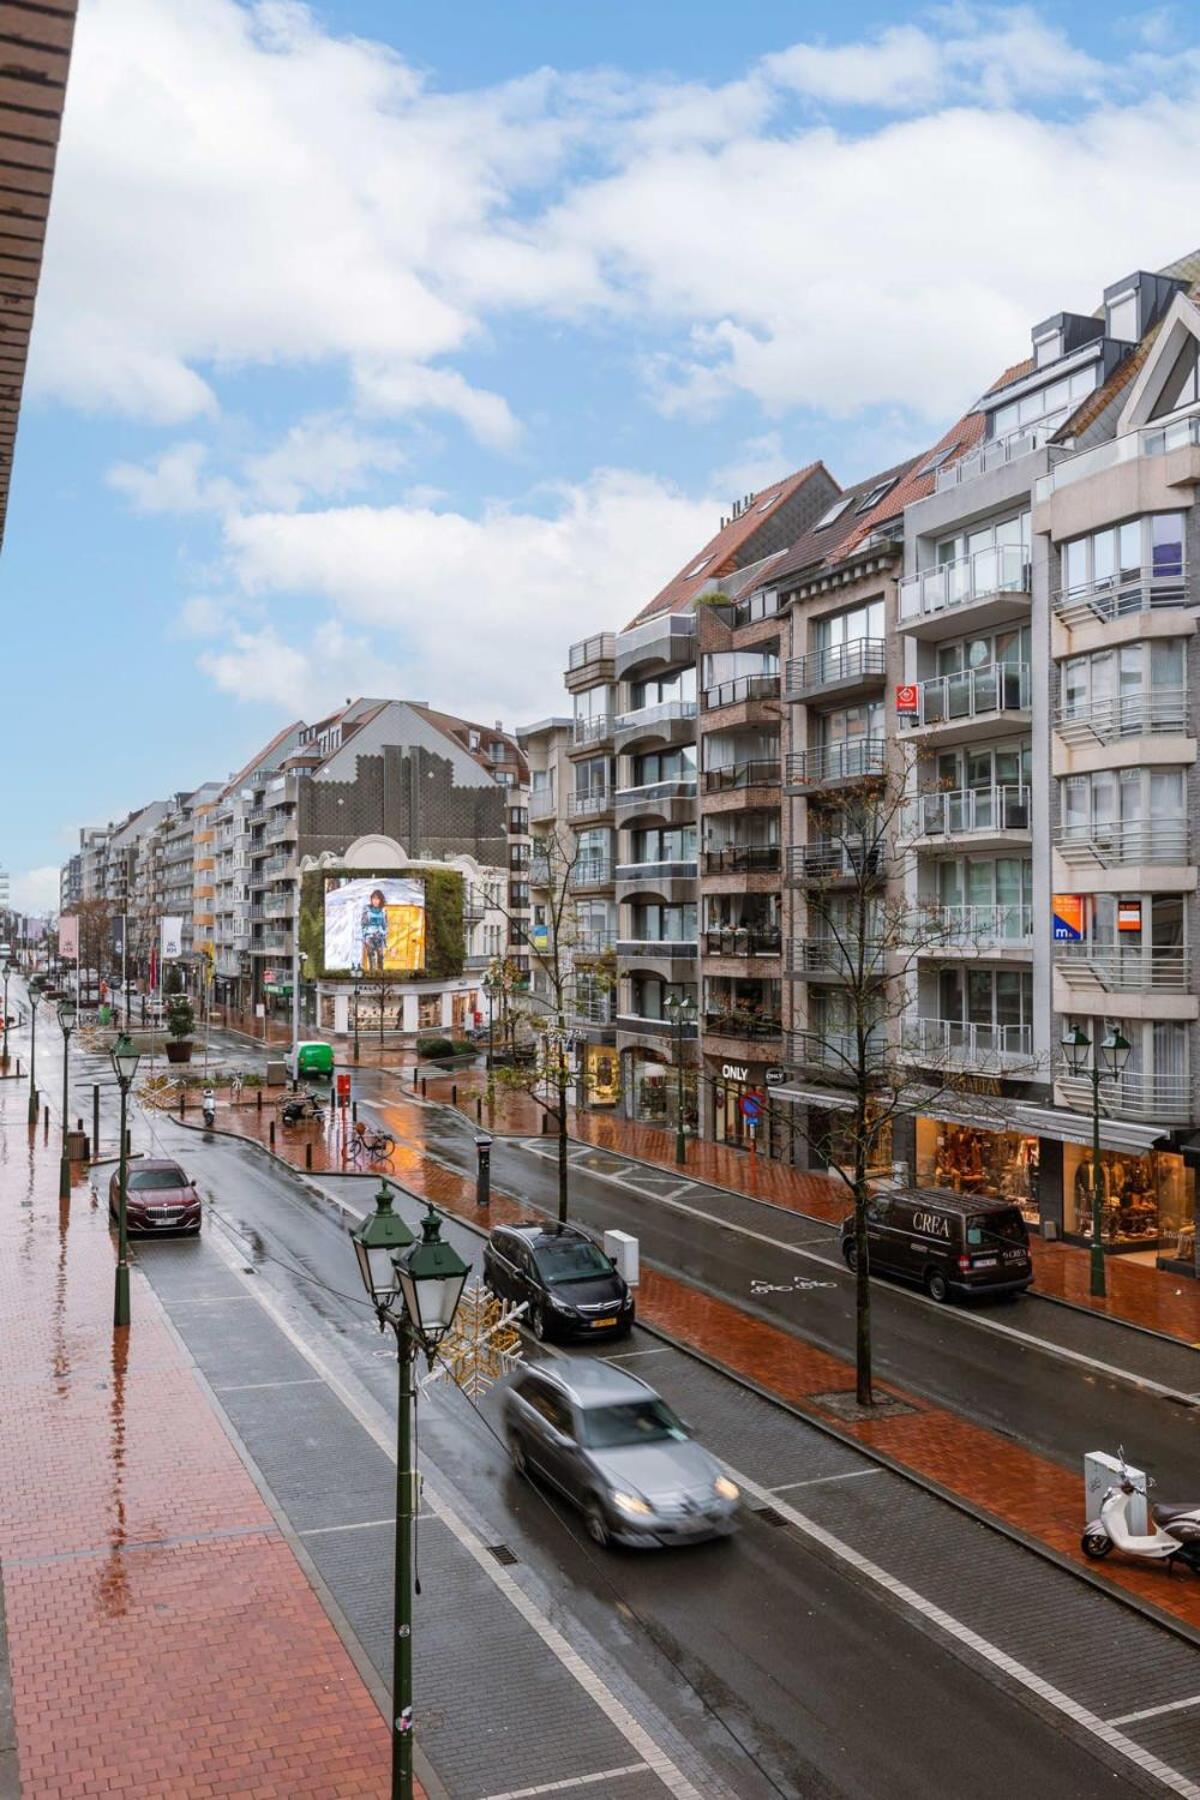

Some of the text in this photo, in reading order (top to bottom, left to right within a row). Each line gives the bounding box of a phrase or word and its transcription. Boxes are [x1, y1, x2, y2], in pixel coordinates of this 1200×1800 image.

[722, 1064, 749, 1081] ONLY
[766, 1072, 783, 1080] ONLY
[912, 1210, 950, 1238] CREA
